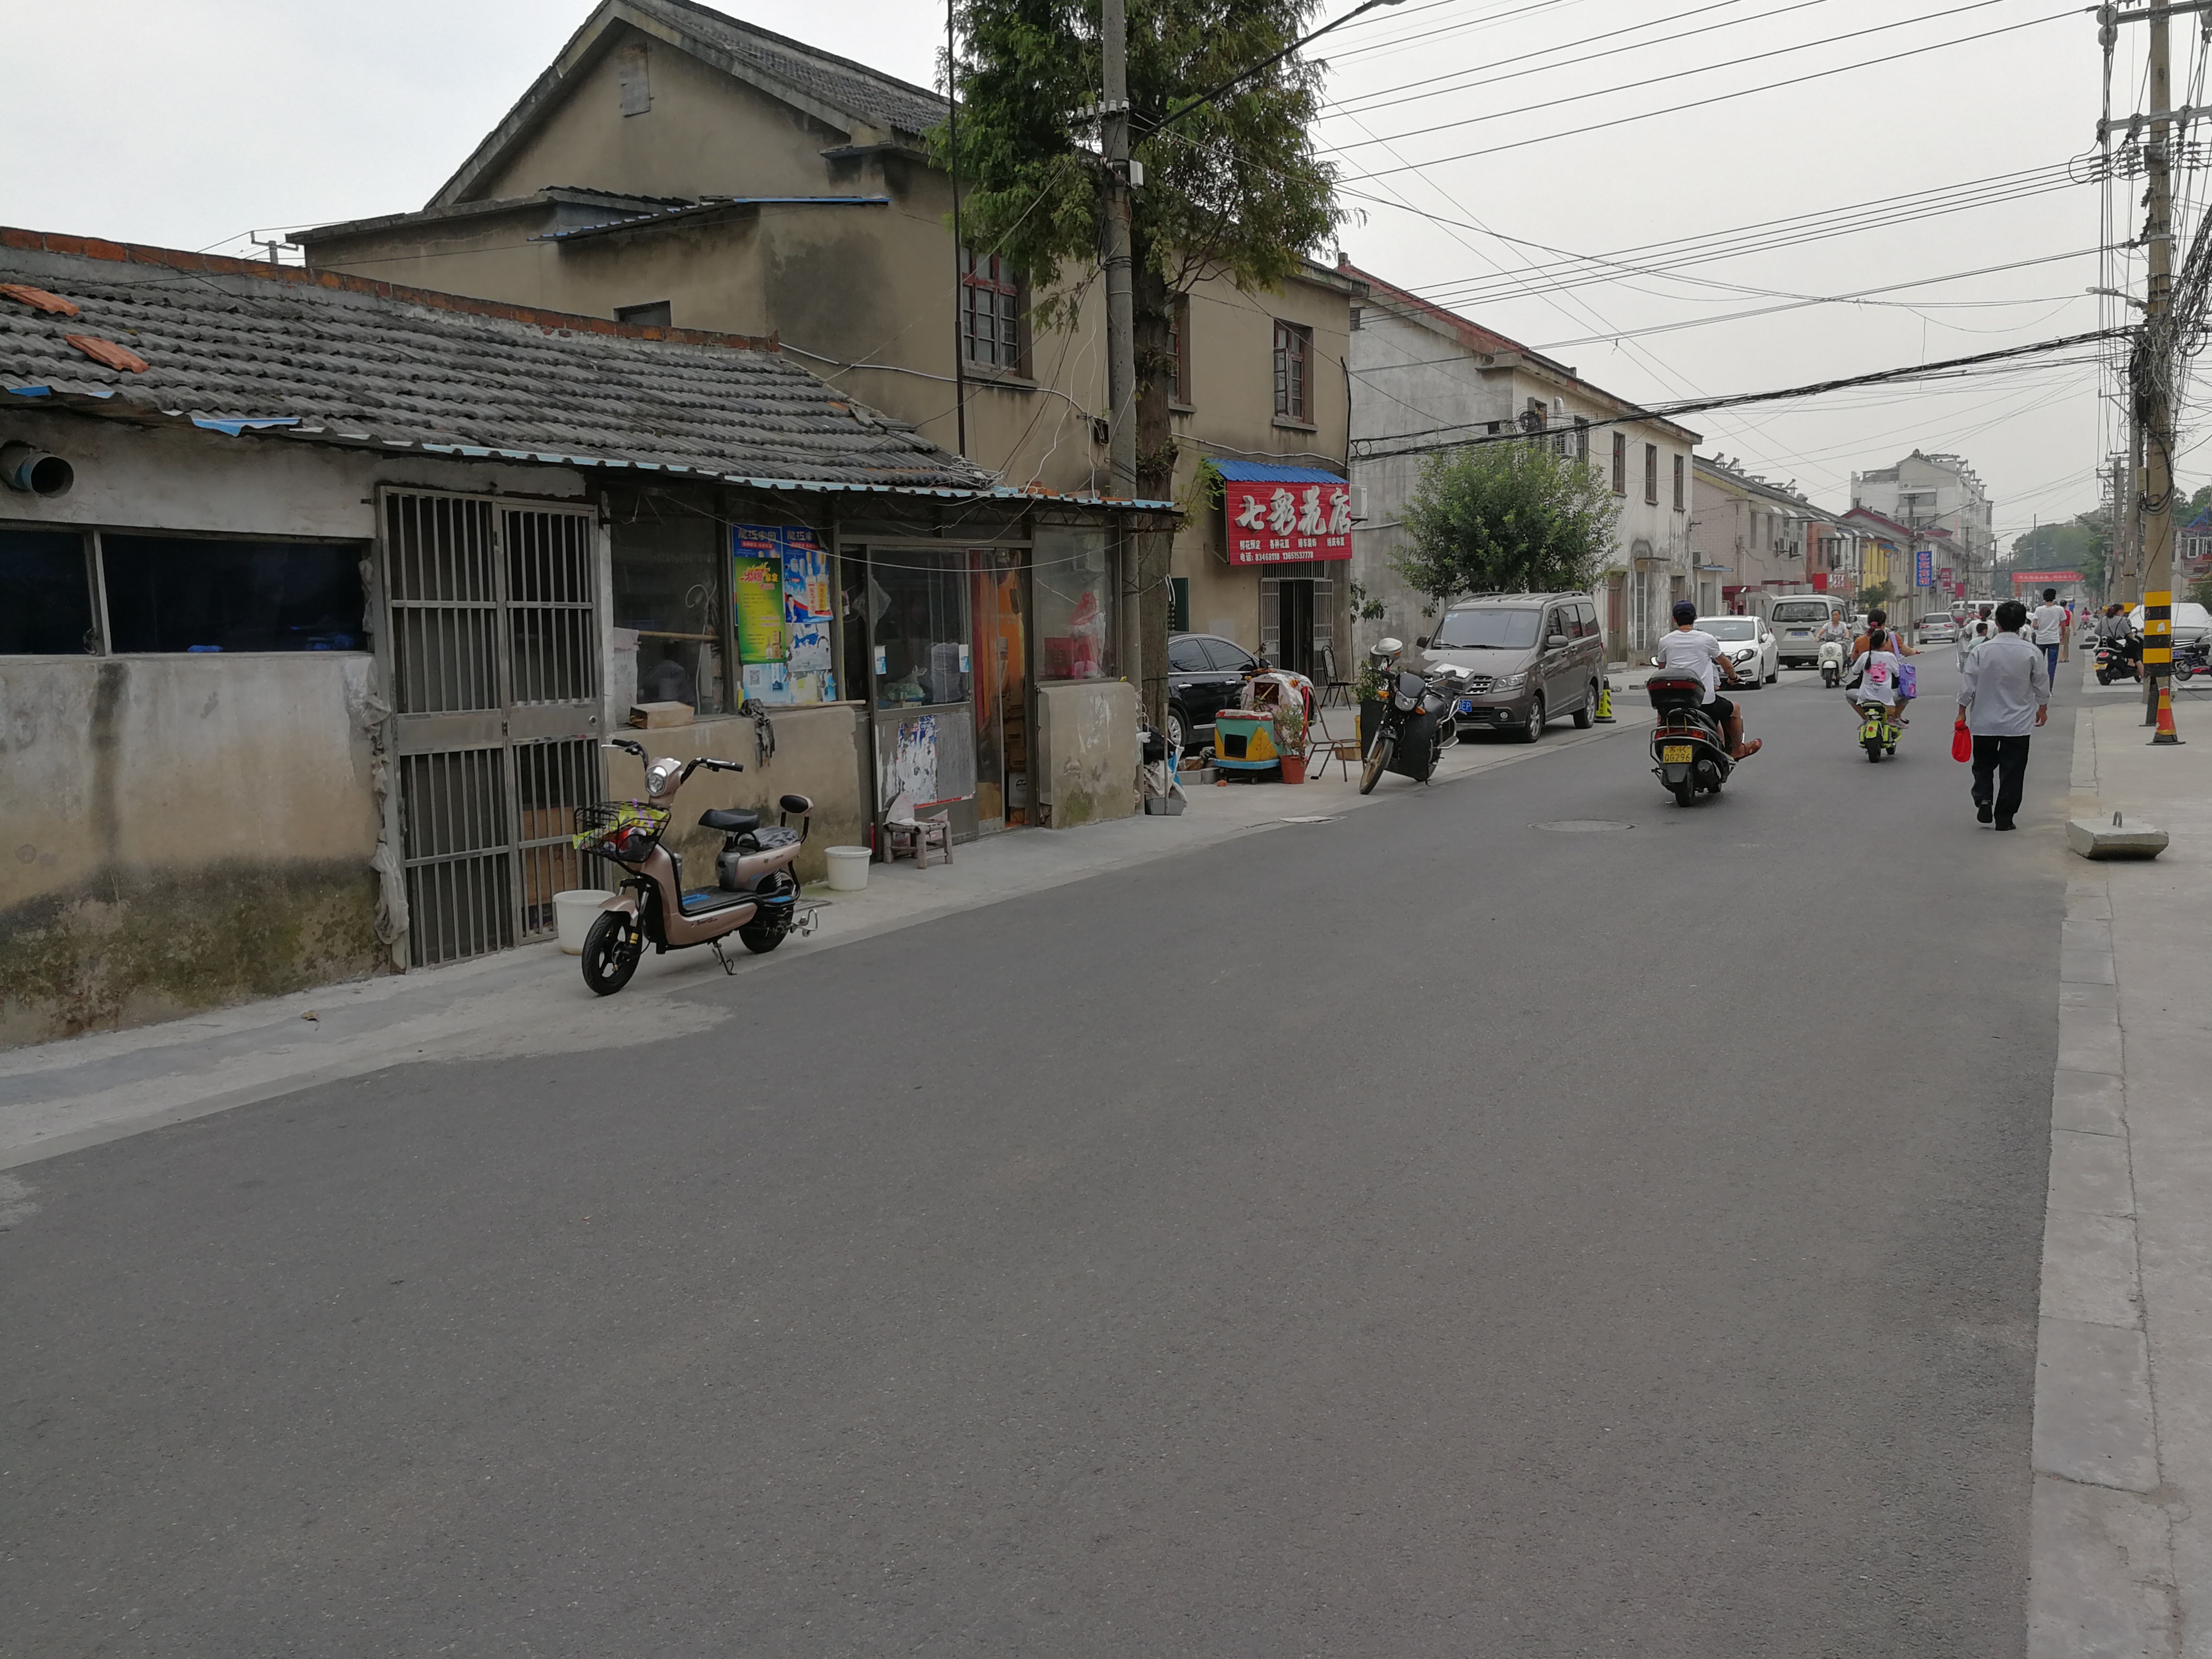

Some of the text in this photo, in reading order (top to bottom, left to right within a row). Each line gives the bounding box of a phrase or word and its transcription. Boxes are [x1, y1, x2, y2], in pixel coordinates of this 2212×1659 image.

[1235, 486, 1351, 536] 七彩花店
[1239, 536, 1345, 550] 鲜花预定 各种花篮 婚车装饰 婚庆布置
[1282, 551, 1314, 560] 13651537778
[1665, 753, 1690, 762] QG296
